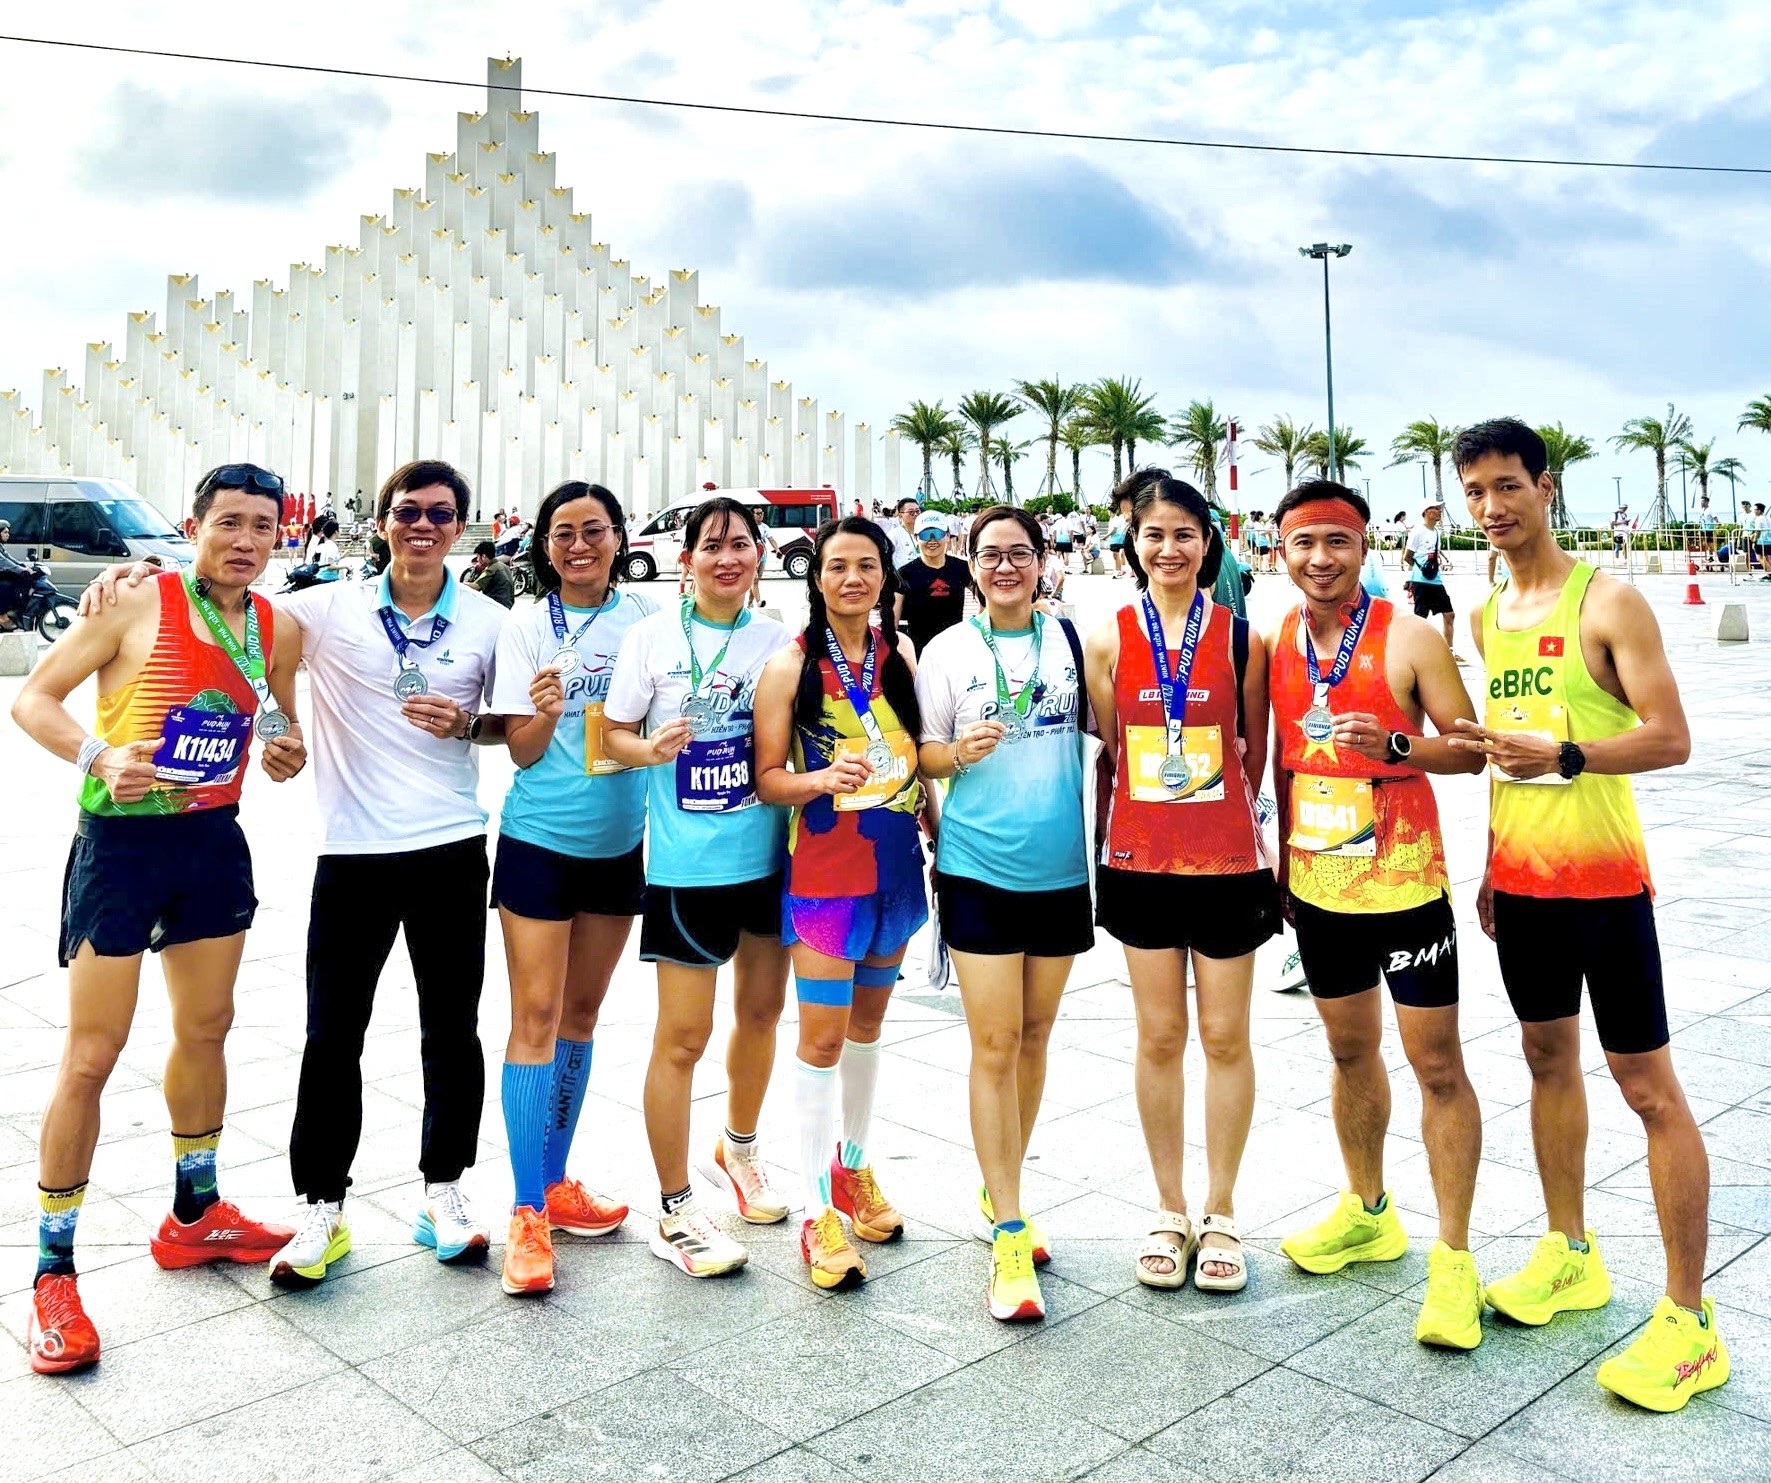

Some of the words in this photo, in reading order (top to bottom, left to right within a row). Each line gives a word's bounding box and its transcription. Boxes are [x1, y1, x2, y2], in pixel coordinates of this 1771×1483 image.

[551, 606, 564, 624] RUN
[1185, 620, 1198, 648] RUN
[249, 635, 260, 657] PUD
[827, 642, 845, 662] RUN
[1334, 654, 1350, 679] PUD
[1344, 623, 1360, 650] RUN
[837, 664, 854, 683] PUD
[1179, 649, 1193, 676] PUD
[862, 672, 873, 693] PUD
[1490, 666, 1553, 699] eBRC
[1142, 691, 1155, 699] LB
[173, 734, 237, 762] K11434
[690, 760, 749, 791] K11438
[567, 1051, 583, 1069] GET
[562, 1073, 576, 1086] IT
[556, 1086, 573, 1131] WANT
